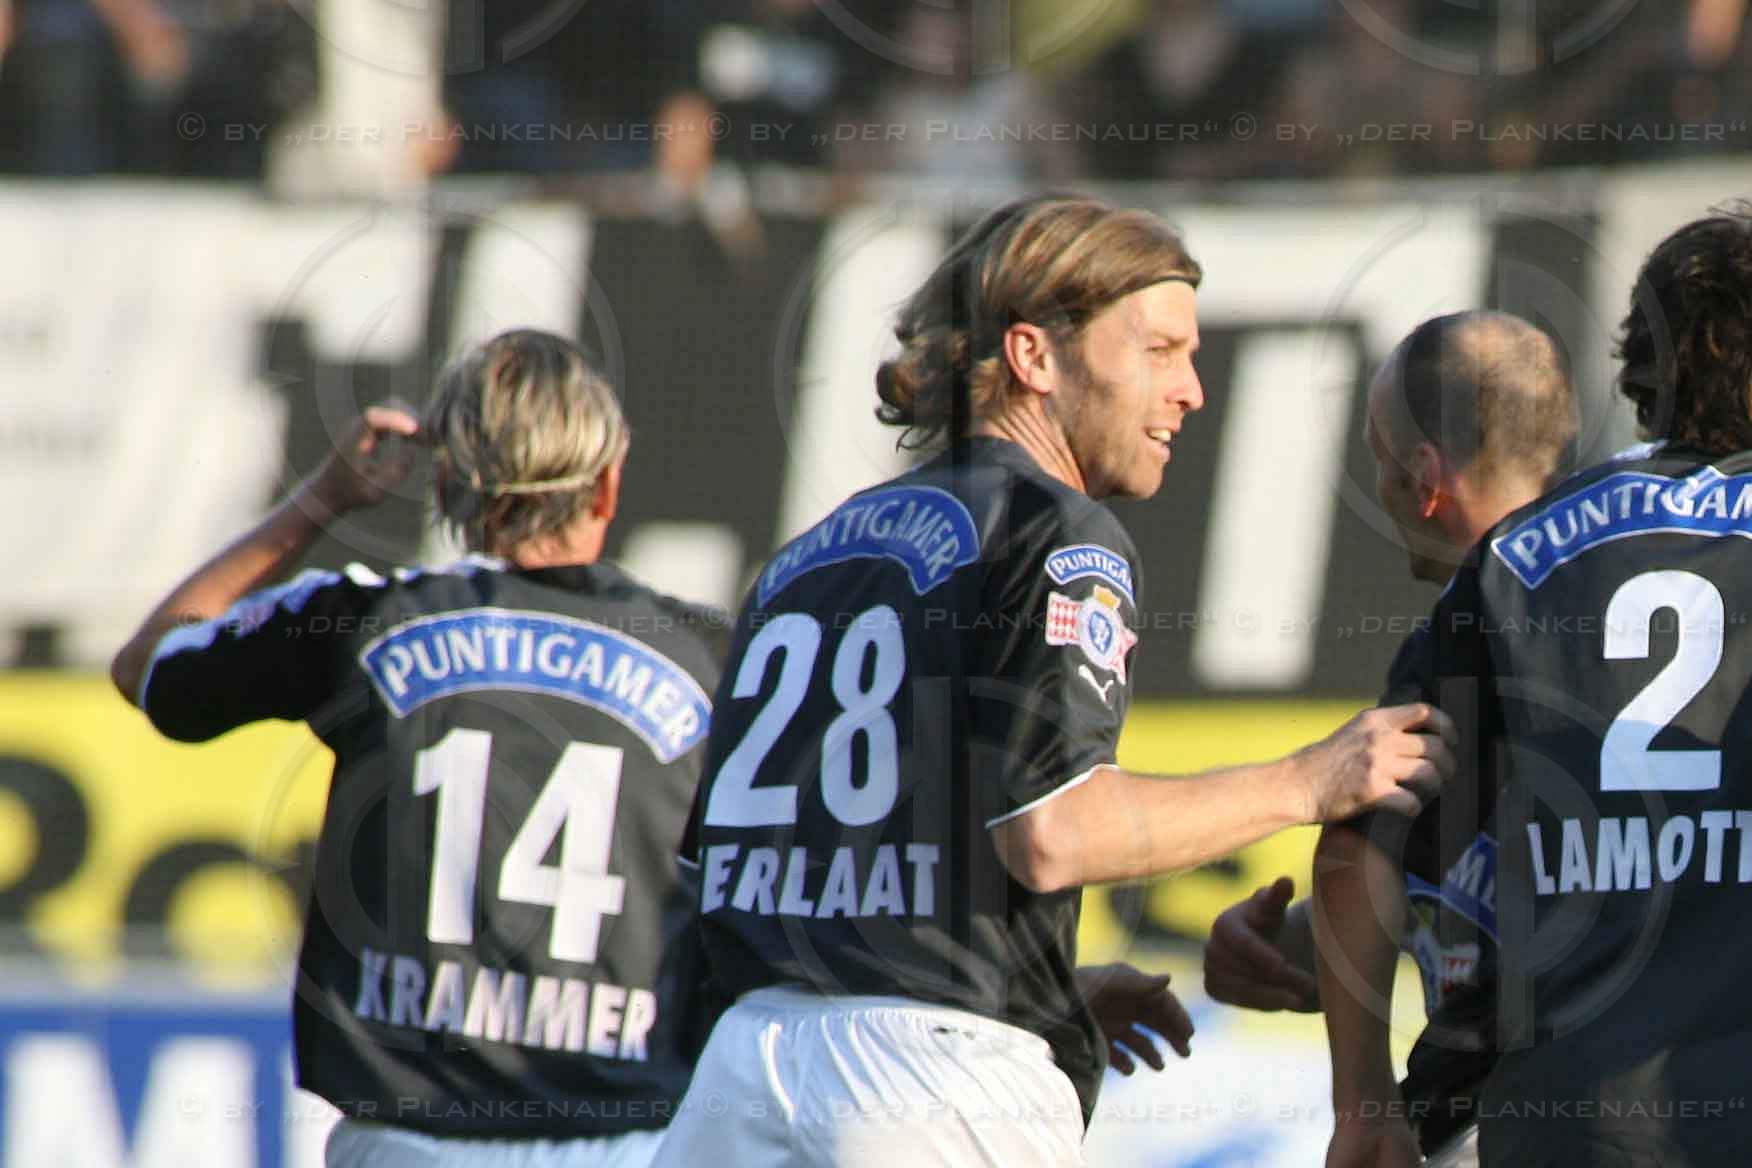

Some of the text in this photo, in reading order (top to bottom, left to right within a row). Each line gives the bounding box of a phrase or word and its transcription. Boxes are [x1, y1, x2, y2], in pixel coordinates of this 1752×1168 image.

[765, 500, 961, 588] PUNTIGAMER
[381, 628, 701, 754] PUNTIGAMER
[704, 604, 906, 828] 28
[1600, 568, 1725, 792] 2
[413, 727, 626, 964] 14
[698, 843, 939, 918] ERLAAT
[355, 948, 658, 1063] KRAMMER
